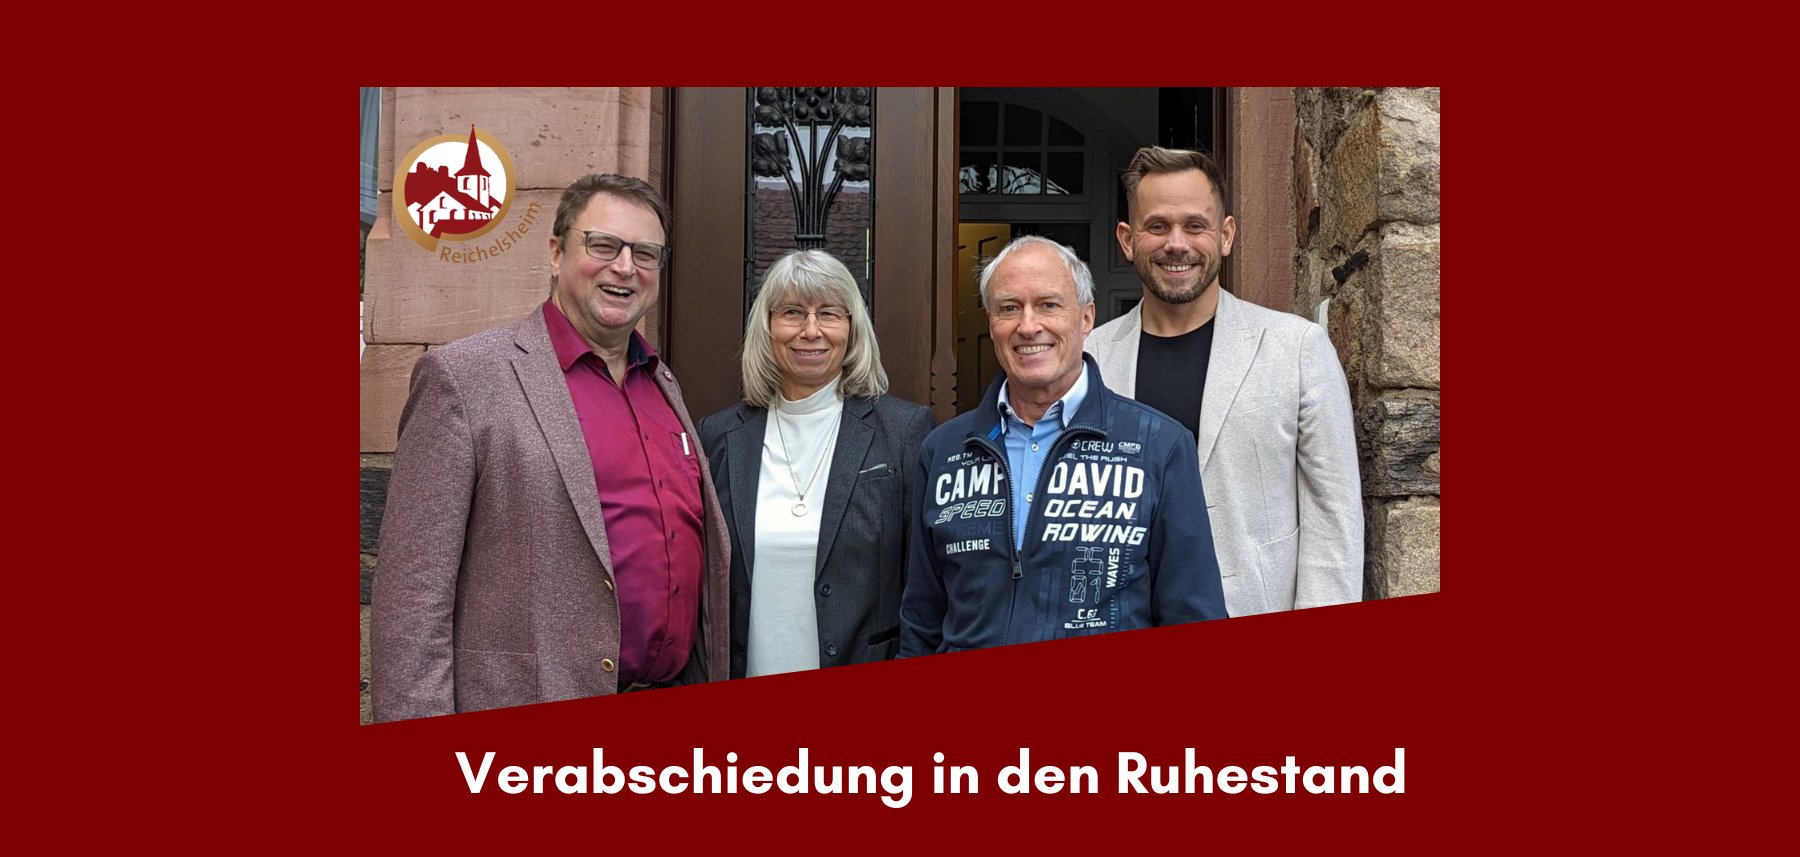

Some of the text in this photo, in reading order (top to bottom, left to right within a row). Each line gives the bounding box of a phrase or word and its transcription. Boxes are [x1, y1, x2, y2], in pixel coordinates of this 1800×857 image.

[1081, 440, 1114, 453] CREW
[935, 462, 1005, 505] CAMP
[1047, 461, 1145, 498] DAVID
[934, 498, 1006, 525] SPEED
[1043, 499, 1136, 519] OCEAN
[1041, 523, 1148, 545] ROWING
[945, 538, 990, 555] CHALLENGE
[1106, 547, 1120, 588] WAVES
